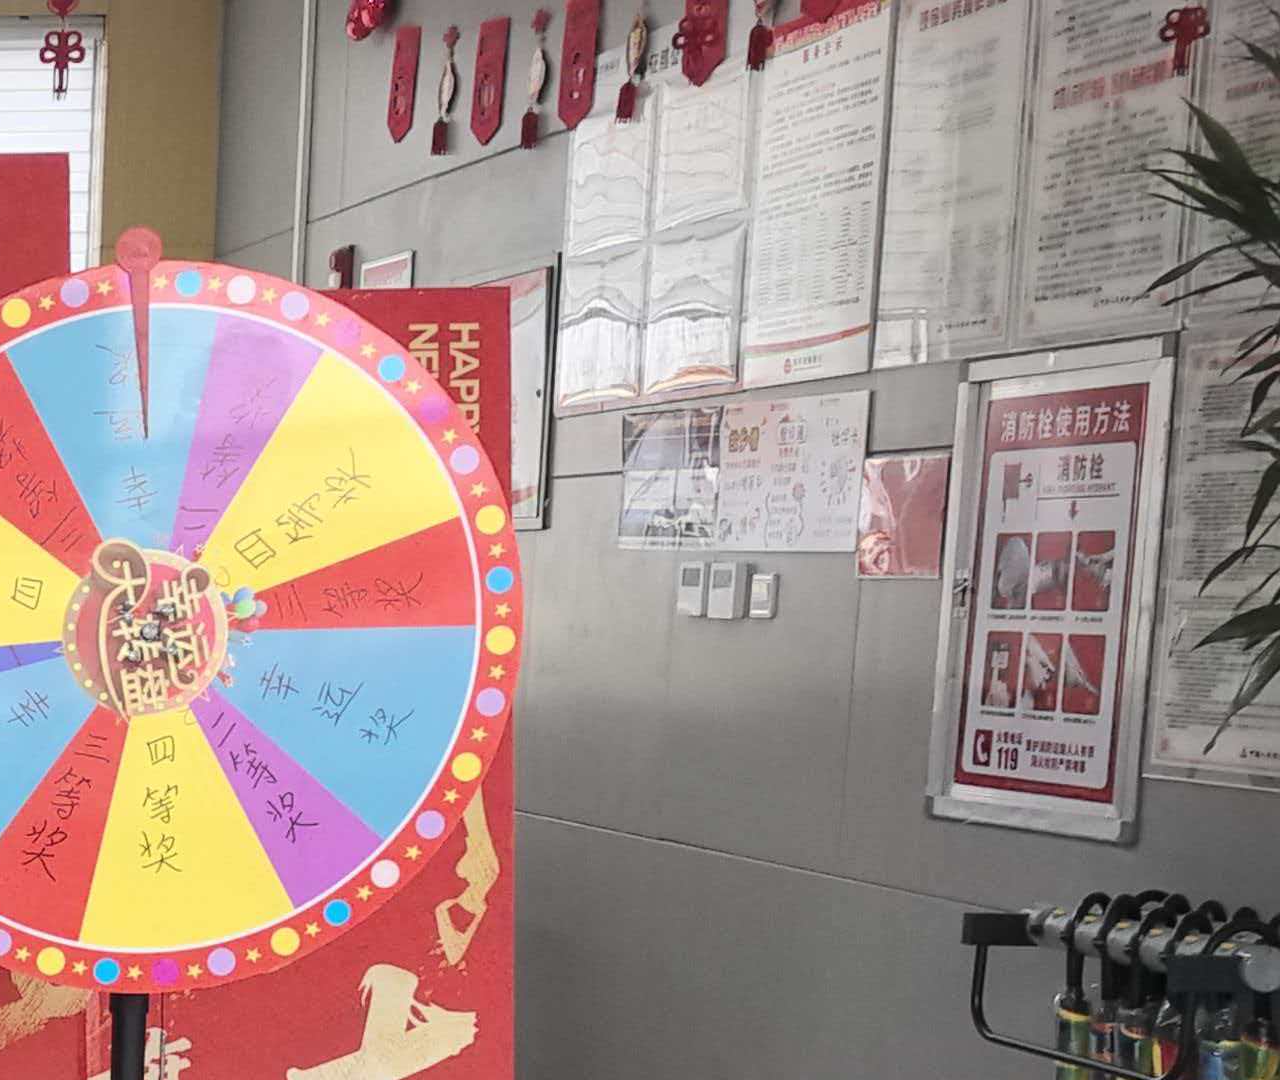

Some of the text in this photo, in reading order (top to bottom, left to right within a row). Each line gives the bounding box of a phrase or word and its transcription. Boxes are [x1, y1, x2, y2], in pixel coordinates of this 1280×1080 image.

[408, 323, 439, 381] NE
[449, 322, 480, 434] HAPP
[1001, 400, 1131, 442] 消防栓使用方法
[1058, 453, 1104, 481] 消防栓
[233, 446, 372, 570] 四等奖
[104, 562, 170, 714] 大转盘
[156, 577, 211, 695] 幸运
[259, 663, 415, 746] 幸运奖
[997, 747, 1018, 770] 119
[21, 735, 110, 882] 三等奖
[140, 735, 183, 874] 四等奖
[210, 711, 320, 844] 二等奖
